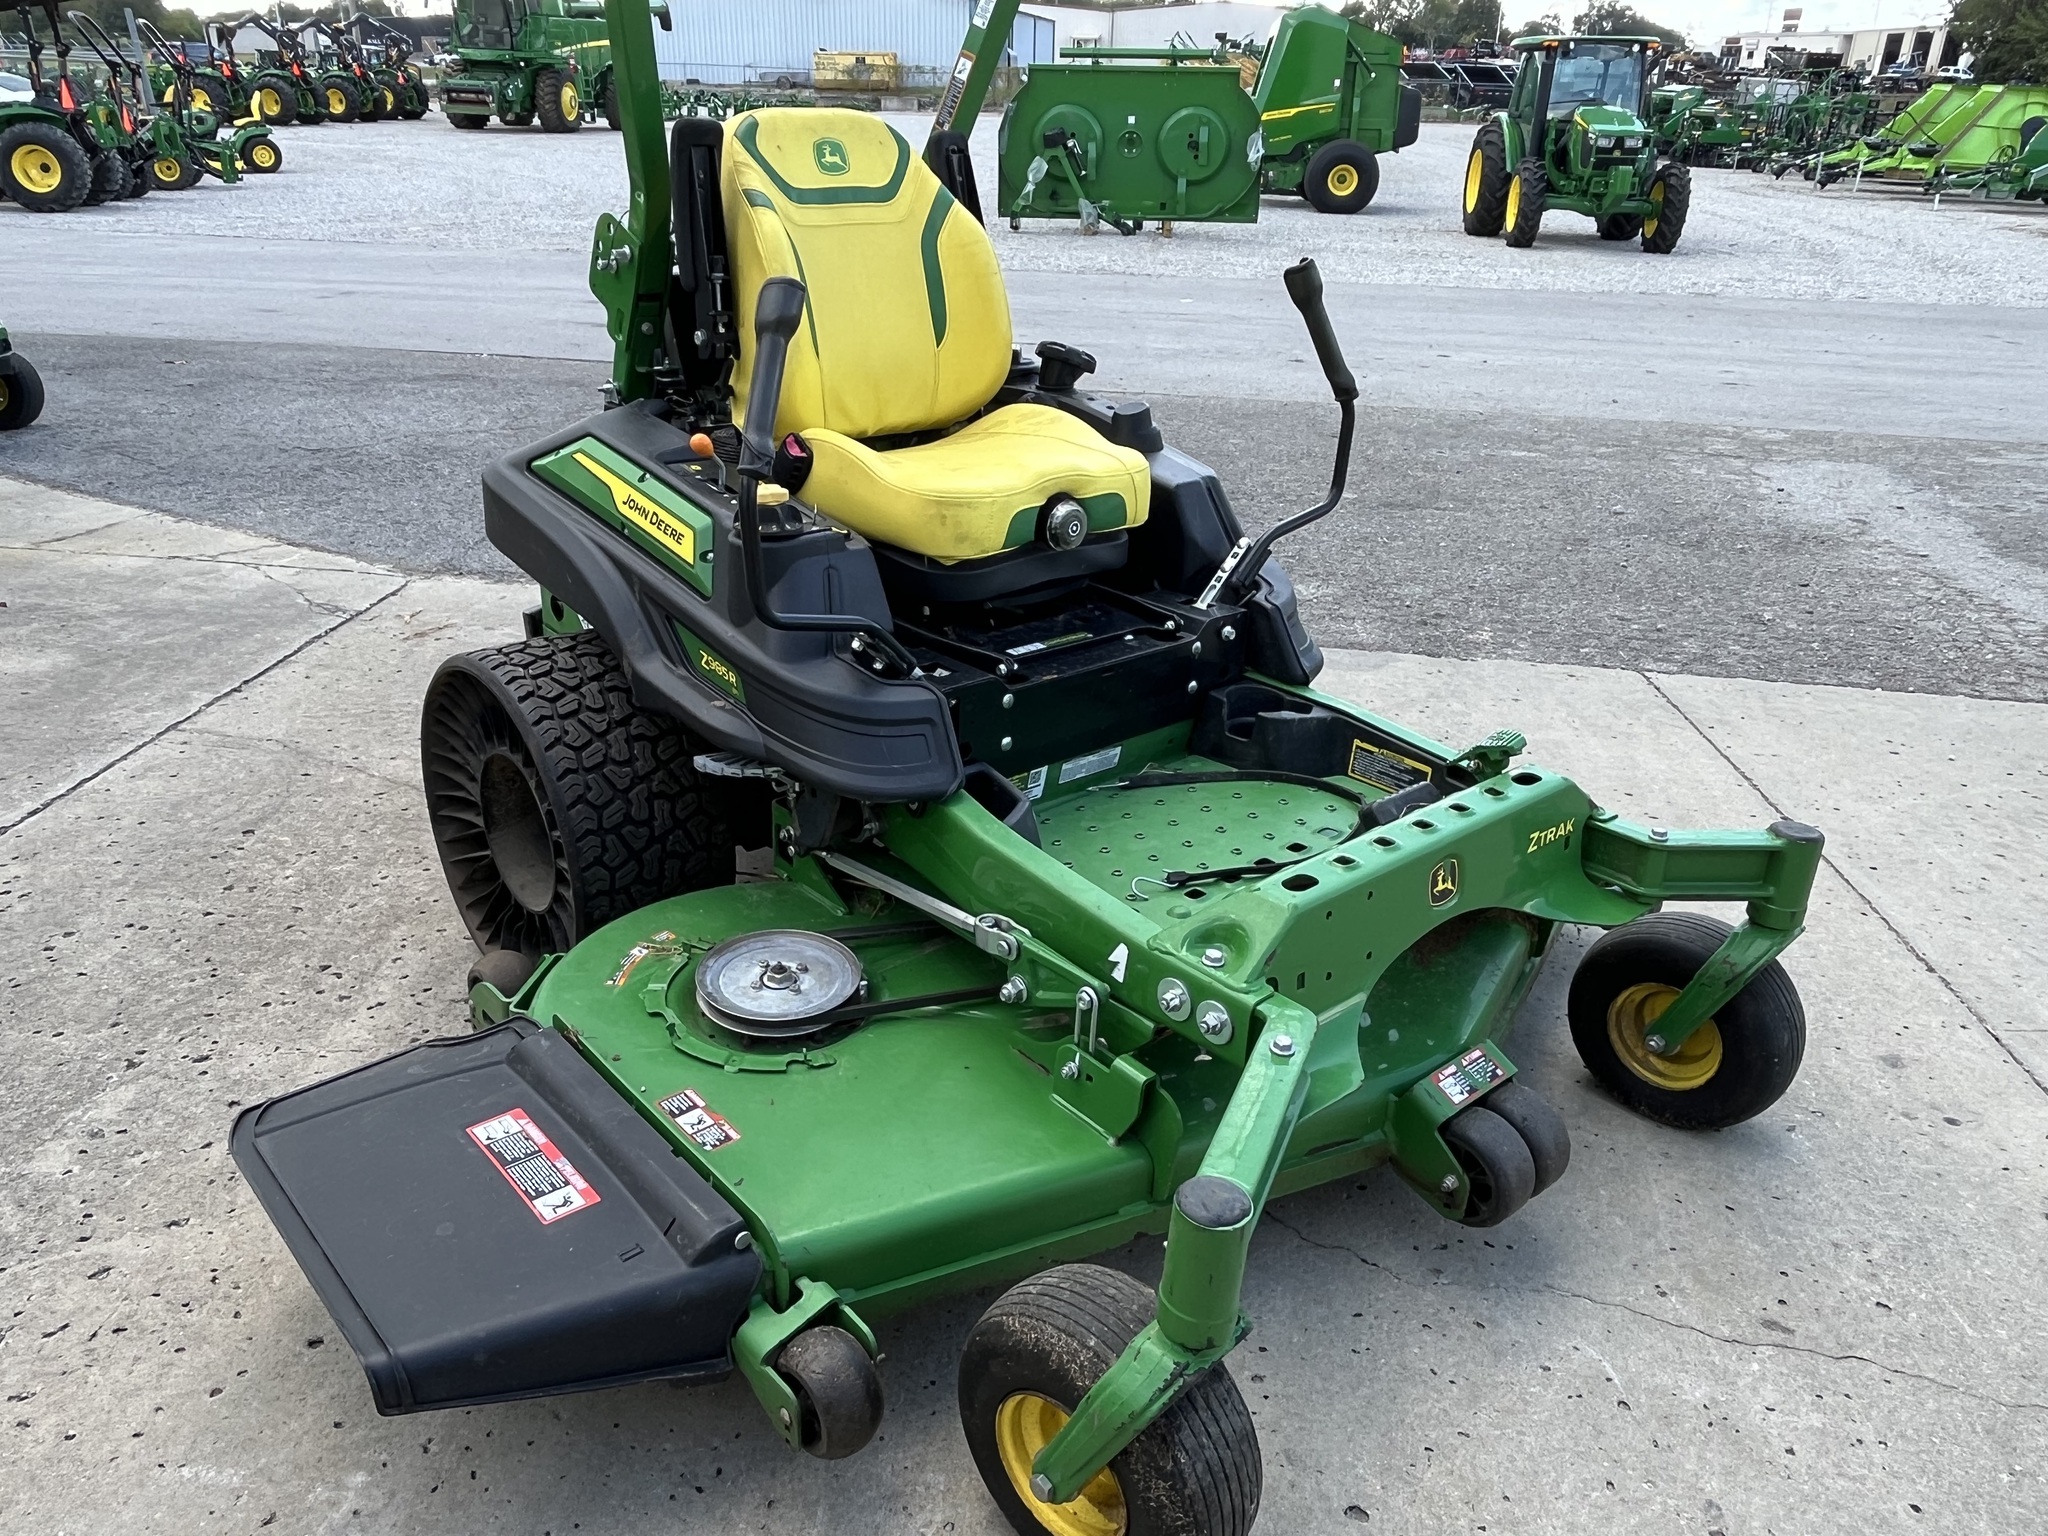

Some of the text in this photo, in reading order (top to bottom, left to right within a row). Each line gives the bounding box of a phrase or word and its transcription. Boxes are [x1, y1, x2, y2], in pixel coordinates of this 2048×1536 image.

[622, 494, 685, 546] JOHN DEERE
[1527, 817, 1576, 854] ZTRAK
